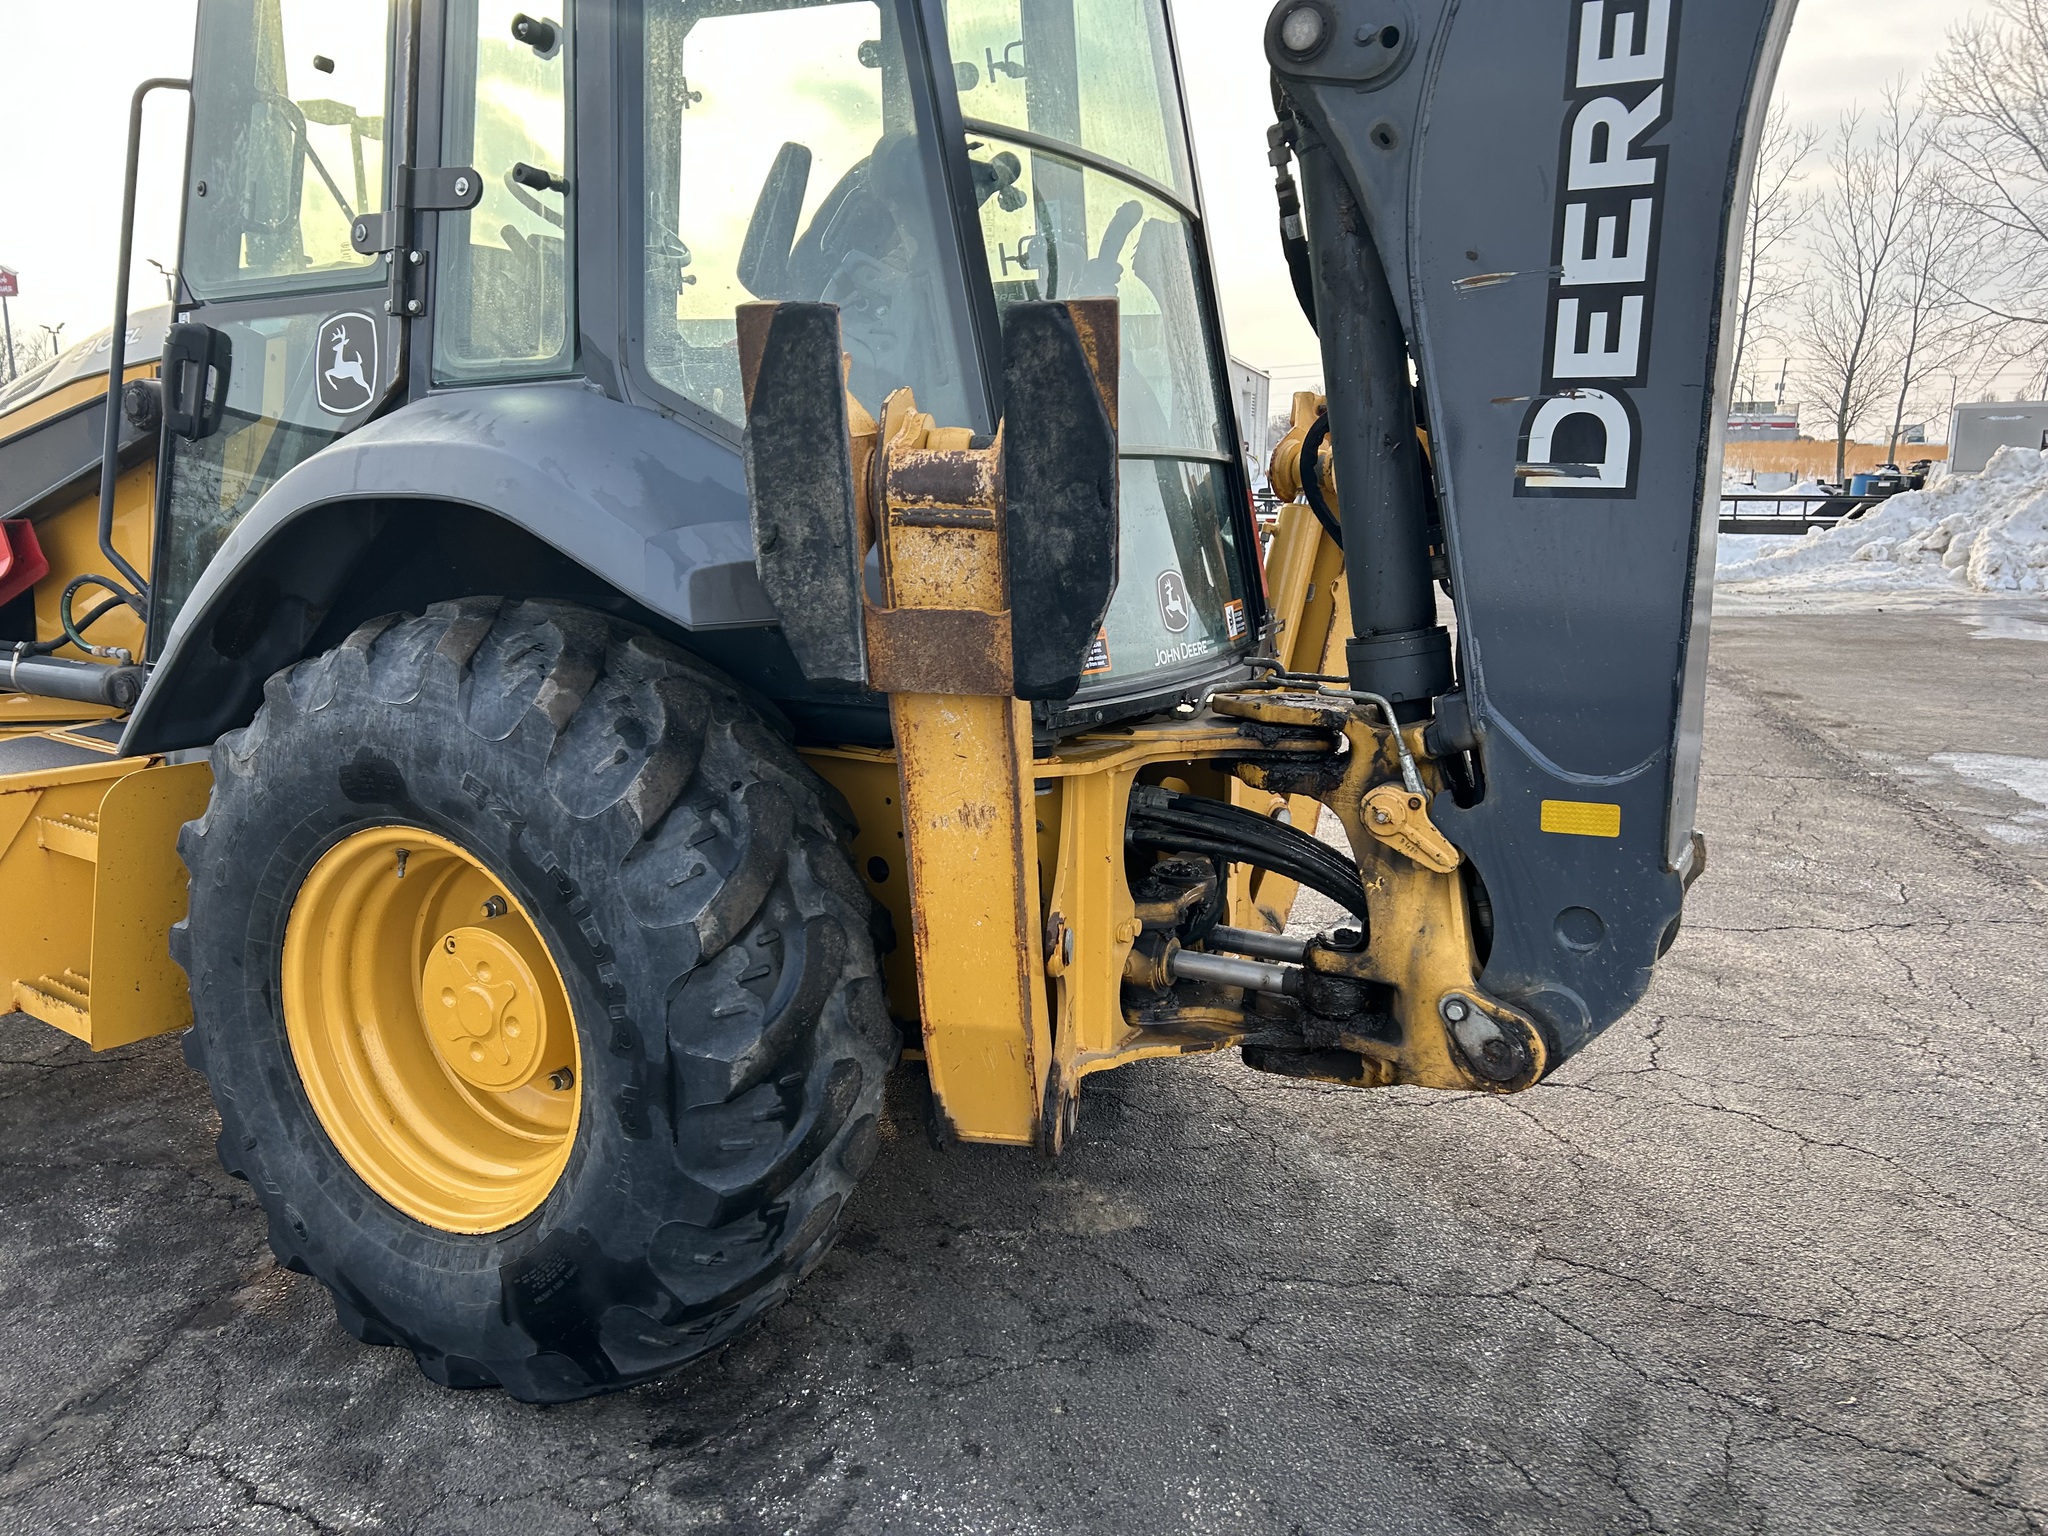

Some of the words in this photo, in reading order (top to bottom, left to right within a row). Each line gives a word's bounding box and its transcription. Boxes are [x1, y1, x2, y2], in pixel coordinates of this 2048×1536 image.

[1526, 0, 1672, 489] DEERE
[1154, 647, 1181, 667] JOHN
[1180, 640, 1208, 660] DEERE
